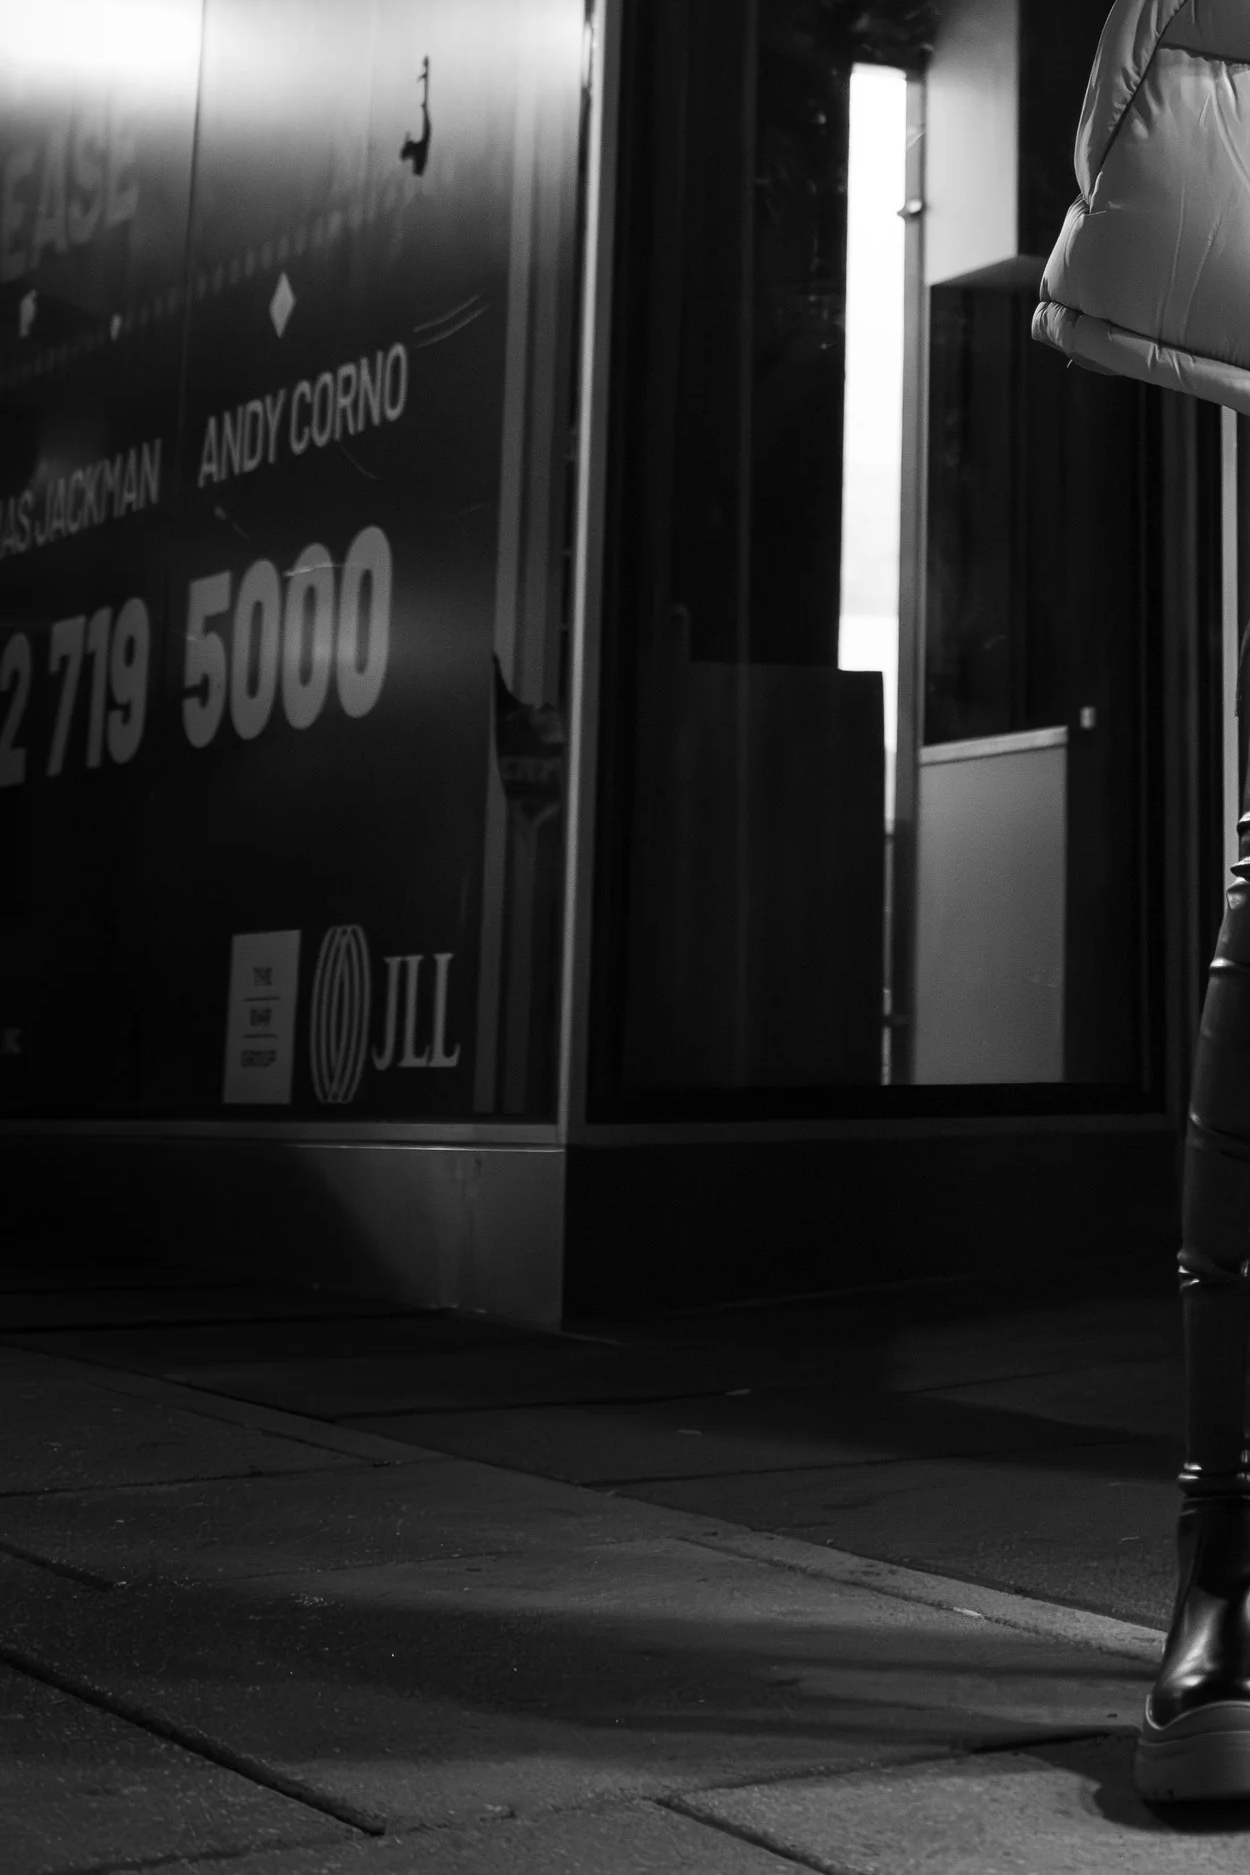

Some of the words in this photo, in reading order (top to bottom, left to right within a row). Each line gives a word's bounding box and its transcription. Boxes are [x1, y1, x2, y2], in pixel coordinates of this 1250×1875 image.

[199, 388, 286, 488] ANDY
[288, 342, 409, 456] CORNO
[34, 437, 162, 546] JACKMAN
[45, 597, 149, 779] 719
[182, 525, 393, 748] 5000
[372, 952, 461, 1071] JLL
